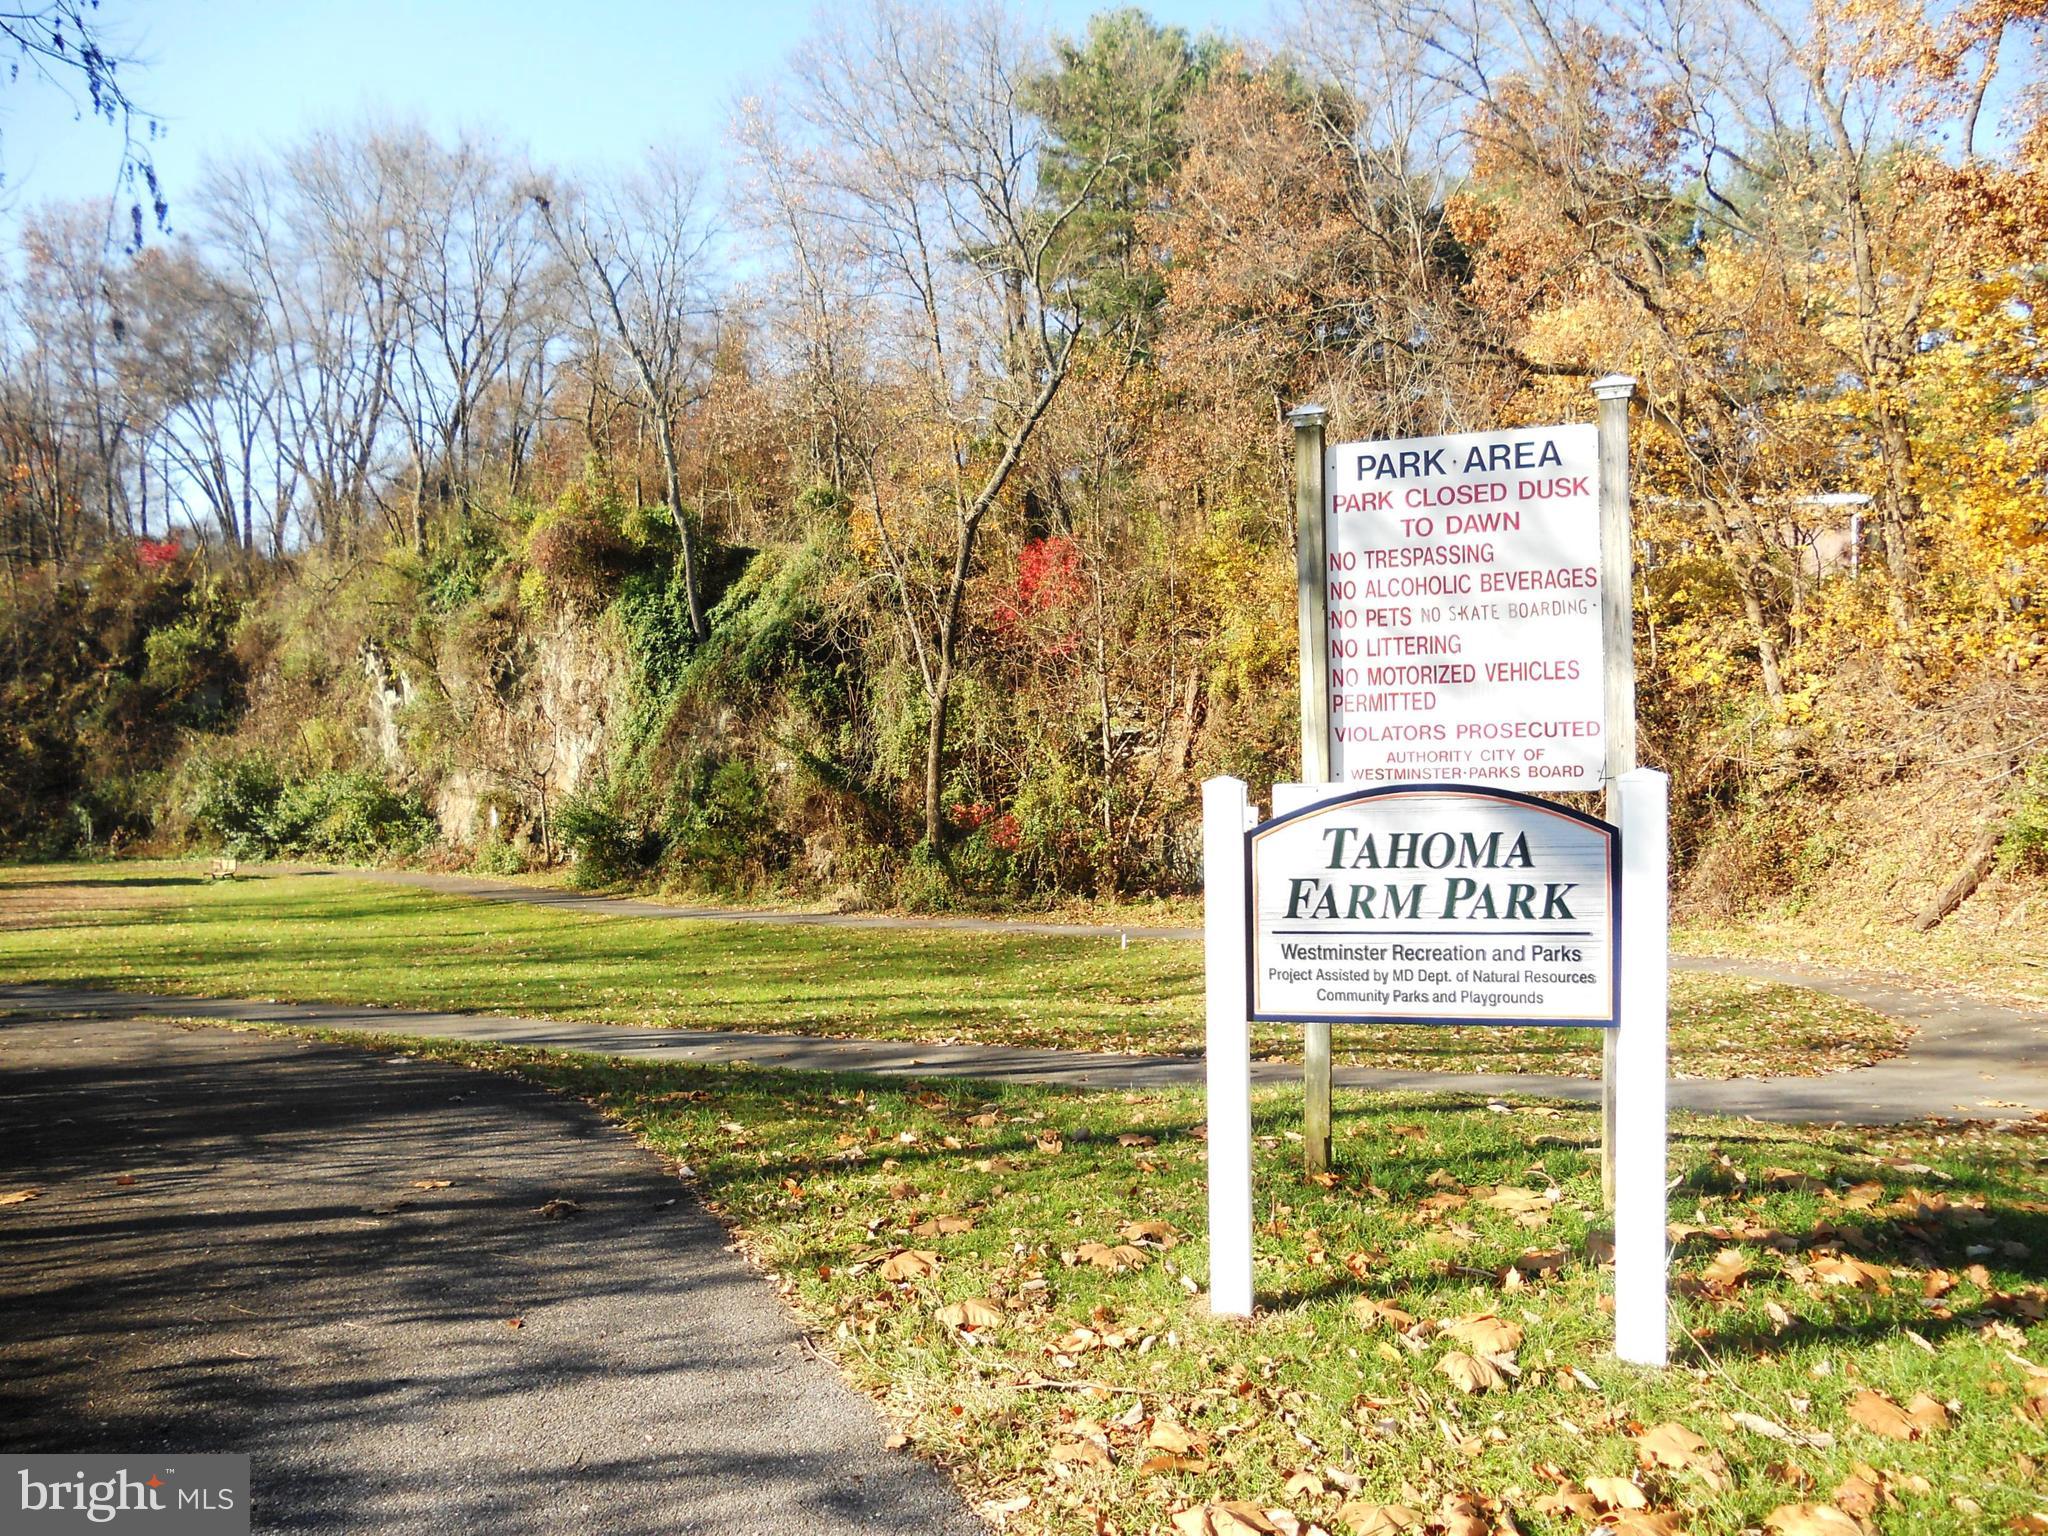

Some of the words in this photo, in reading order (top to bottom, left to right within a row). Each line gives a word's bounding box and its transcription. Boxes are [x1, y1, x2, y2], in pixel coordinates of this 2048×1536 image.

[1358, 449, 1446, 480] PARK
[1463, 441, 1562, 473] AREA
[1332, 491, 1393, 513] PARK
[1405, 483, 1507, 508] CLOSED
[1518, 476, 1590, 500] DUSK
[1401, 517, 1433, 538] TO
[1446, 512, 1520, 534] DAWN
[1330, 552, 1356, 571] NO
[1364, 543, 1494, 569] TRESPASSING
[1331, 581, 1356, 600] NO
[1365, 575, 1470, 598] ALCOHOLIC
[1481, 567, 1597, 592] BEVERAGES
[1331, 610, 1357, 629] NO
[1366, 607, 1411, 627] PETS
[1421, 606, 1441, 623] NO
[1449, 604, 1499, 622] SKATE
[1508, 603, 1588, 619] BOARDING
[1332, 639, 1357, 658] NO
[1366, 634, 1461, 657] LITTERING
[1333, 669, 1358, 687] NO
[1367, 664, 1476, 686] MOTORIZED
[1485, 660, 1580, 682] VEHICLES
[1333, 692, 1436, 713] PERMITTED
[1335, 724, 1446, 743] VIOLATORS
[1457, 721, 1600, 739] PROSECUTED
[1387, 750, 1471, 763] AUTHORITY
[1480, 749, 1515, 761] CITY
[1524, 749, 1545, 761] OF
[1351, 768, 1461, 780] WESTMINSTER
[1469, 766, 1520, 778] PARKS
[1529, 765, 1584, 778] BOARD
[1323, 827, 1536, 869] TAHOMA
[1283, 878, 1427, 919] FARM
[1439, 878, 1579, 920] PARK
[1281, 943, 1388, 961] Westminster
[1393, 944, 1486, 962] Recreation
[1493, 945, 1525, 962] and
[1531, 945, 1582, 962] Parks
[1269, 968, 1312, 983] Project
[1316, 968, 1369, 982] Assisted
[1373, 969, 1389, 984] by
[1393, 969, 1414, 982] MD
[1418, 969, 1452, 986] Dept.
[1457, 970, 1469, 983] of
[1473, 970, 1520, 984] Natural
[1524, 970, 1596, 984] Resources
[1316, 988, 1389, 1005] Community
[1393, 989, 1429, 1003] Parks
[1432, 990, 1457, 1003] and
[1460, 990, 1543, 1006] Playgrounds
